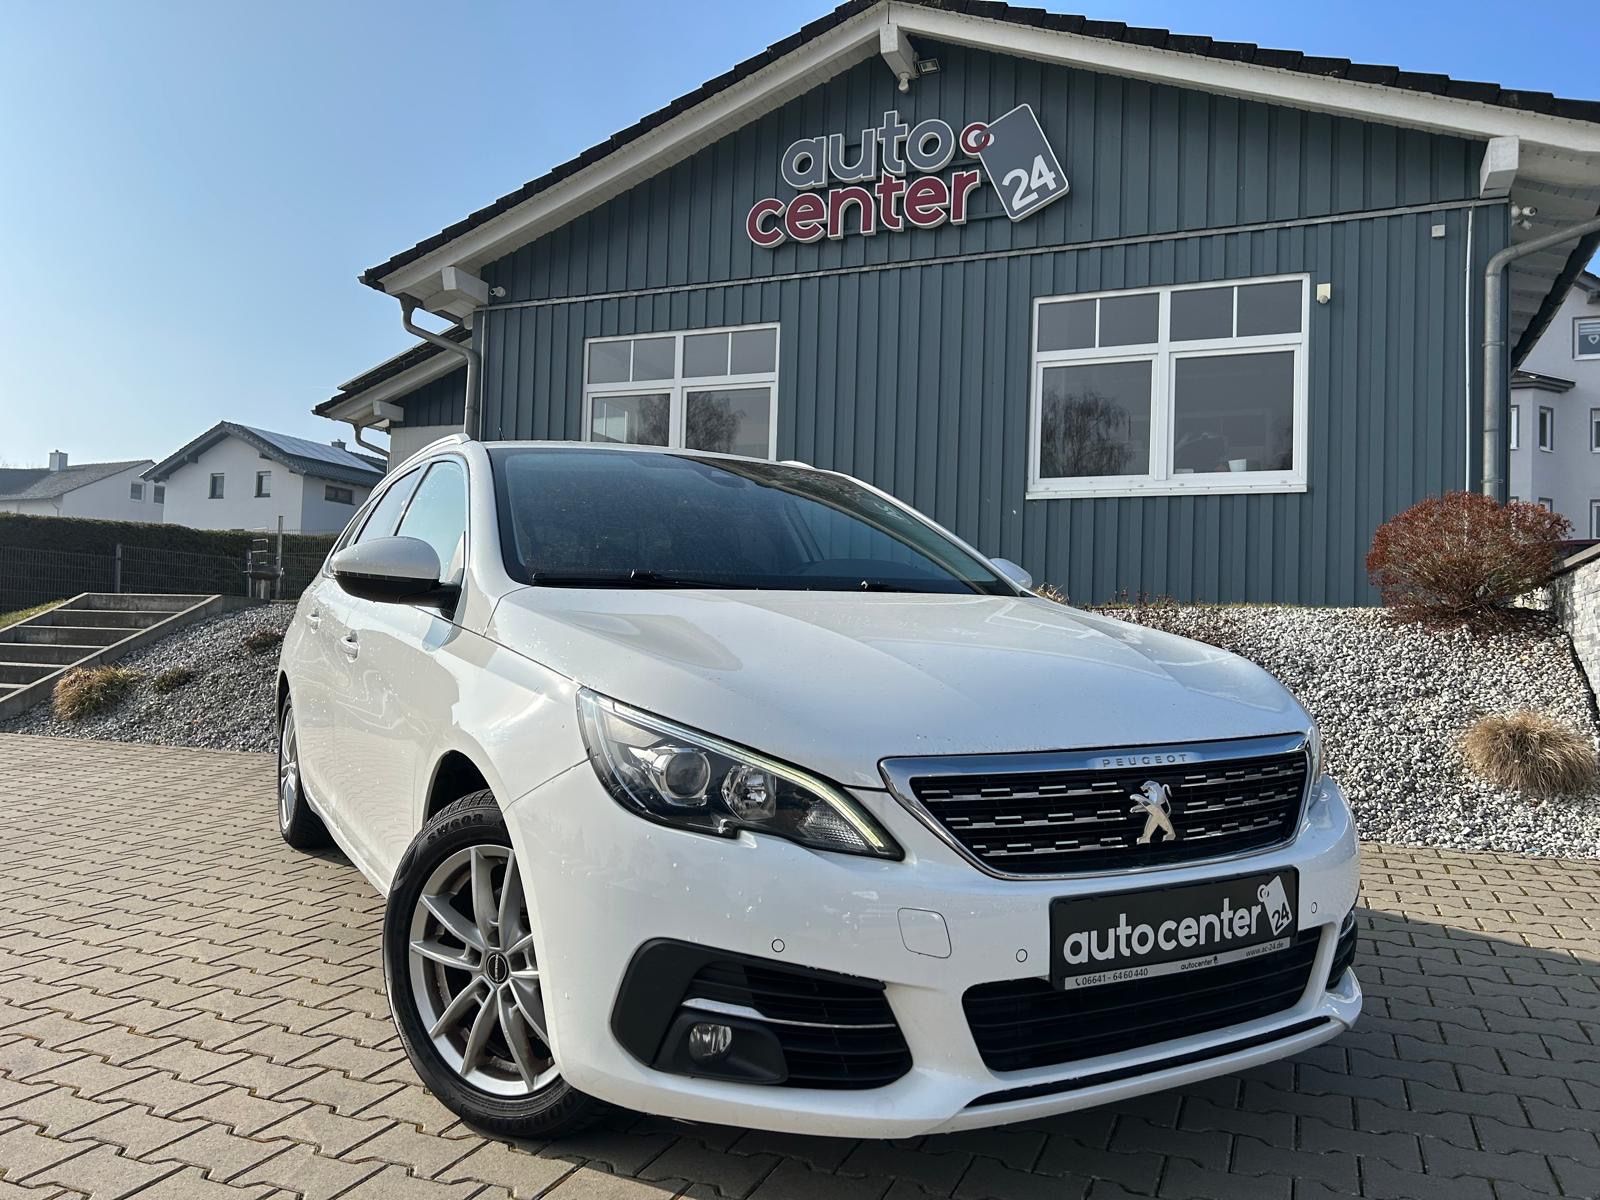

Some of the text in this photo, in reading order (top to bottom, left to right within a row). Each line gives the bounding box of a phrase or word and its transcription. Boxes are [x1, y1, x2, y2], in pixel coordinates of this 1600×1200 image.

[781, 110, 956, 191] auto
[746, 167, 981, 249] center
[1001, 154, 1058, 212] 24
[1102, 753, 1187, 768] PEUGEOT
[1271, 901, 1290, 932] 24
